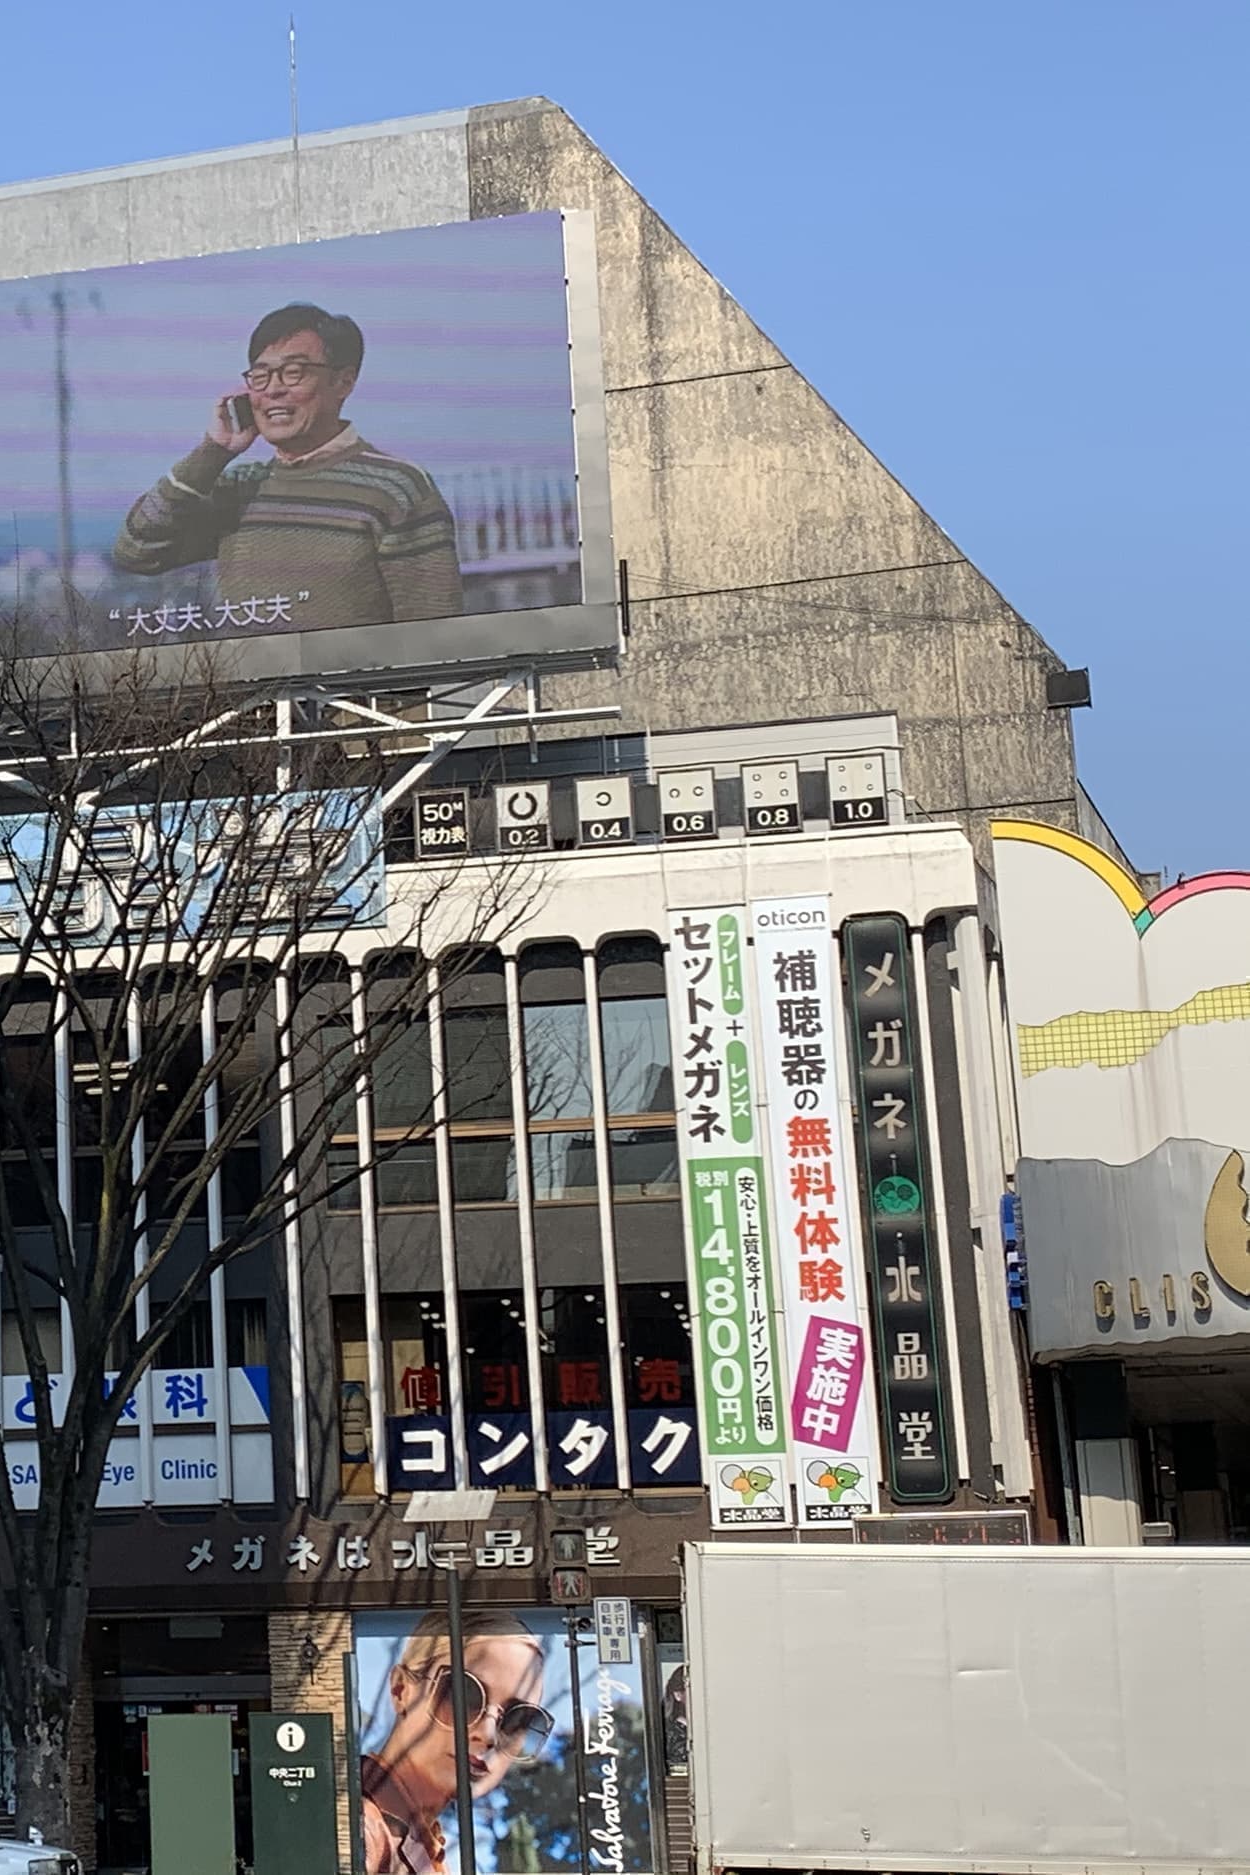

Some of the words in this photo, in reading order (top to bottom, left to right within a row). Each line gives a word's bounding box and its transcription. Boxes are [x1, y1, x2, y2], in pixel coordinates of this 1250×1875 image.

[590, 822, 621, 840] 0.4
[672, 814, 704, 833] 0.6
[756, 808, 789, 827] 0.8
[845, 801, 873, 819] 1.0
[421, 826, 466, 846] 視力表
[508, 828, 539, 846] 0.2
[757, 909, 826, 927] oticon
[719, 930, 741, 1001] フレーム
[674, 916, 726, 1143] セットメガネ
[864, 952, 908, 1140] メガネ
[729, 1063, 750, 1118] レンズ
[772, 949, 846, 1305] 補聴器の無料体験
[695, 1169, 729, 1187] 税別
[1092, 1271, 1212, 1319] CLIS
[885, 1256, 935, 1460] 水晶堂
[799, 1325, 859, 1443] 実施中
[402, 1415, 693, 1476] コンタク
[100, 1463, 135, 1487] Eye
[161, 1458, 219, 1481] Clinic
[587, 1757, 626, 1874] Salvatore
